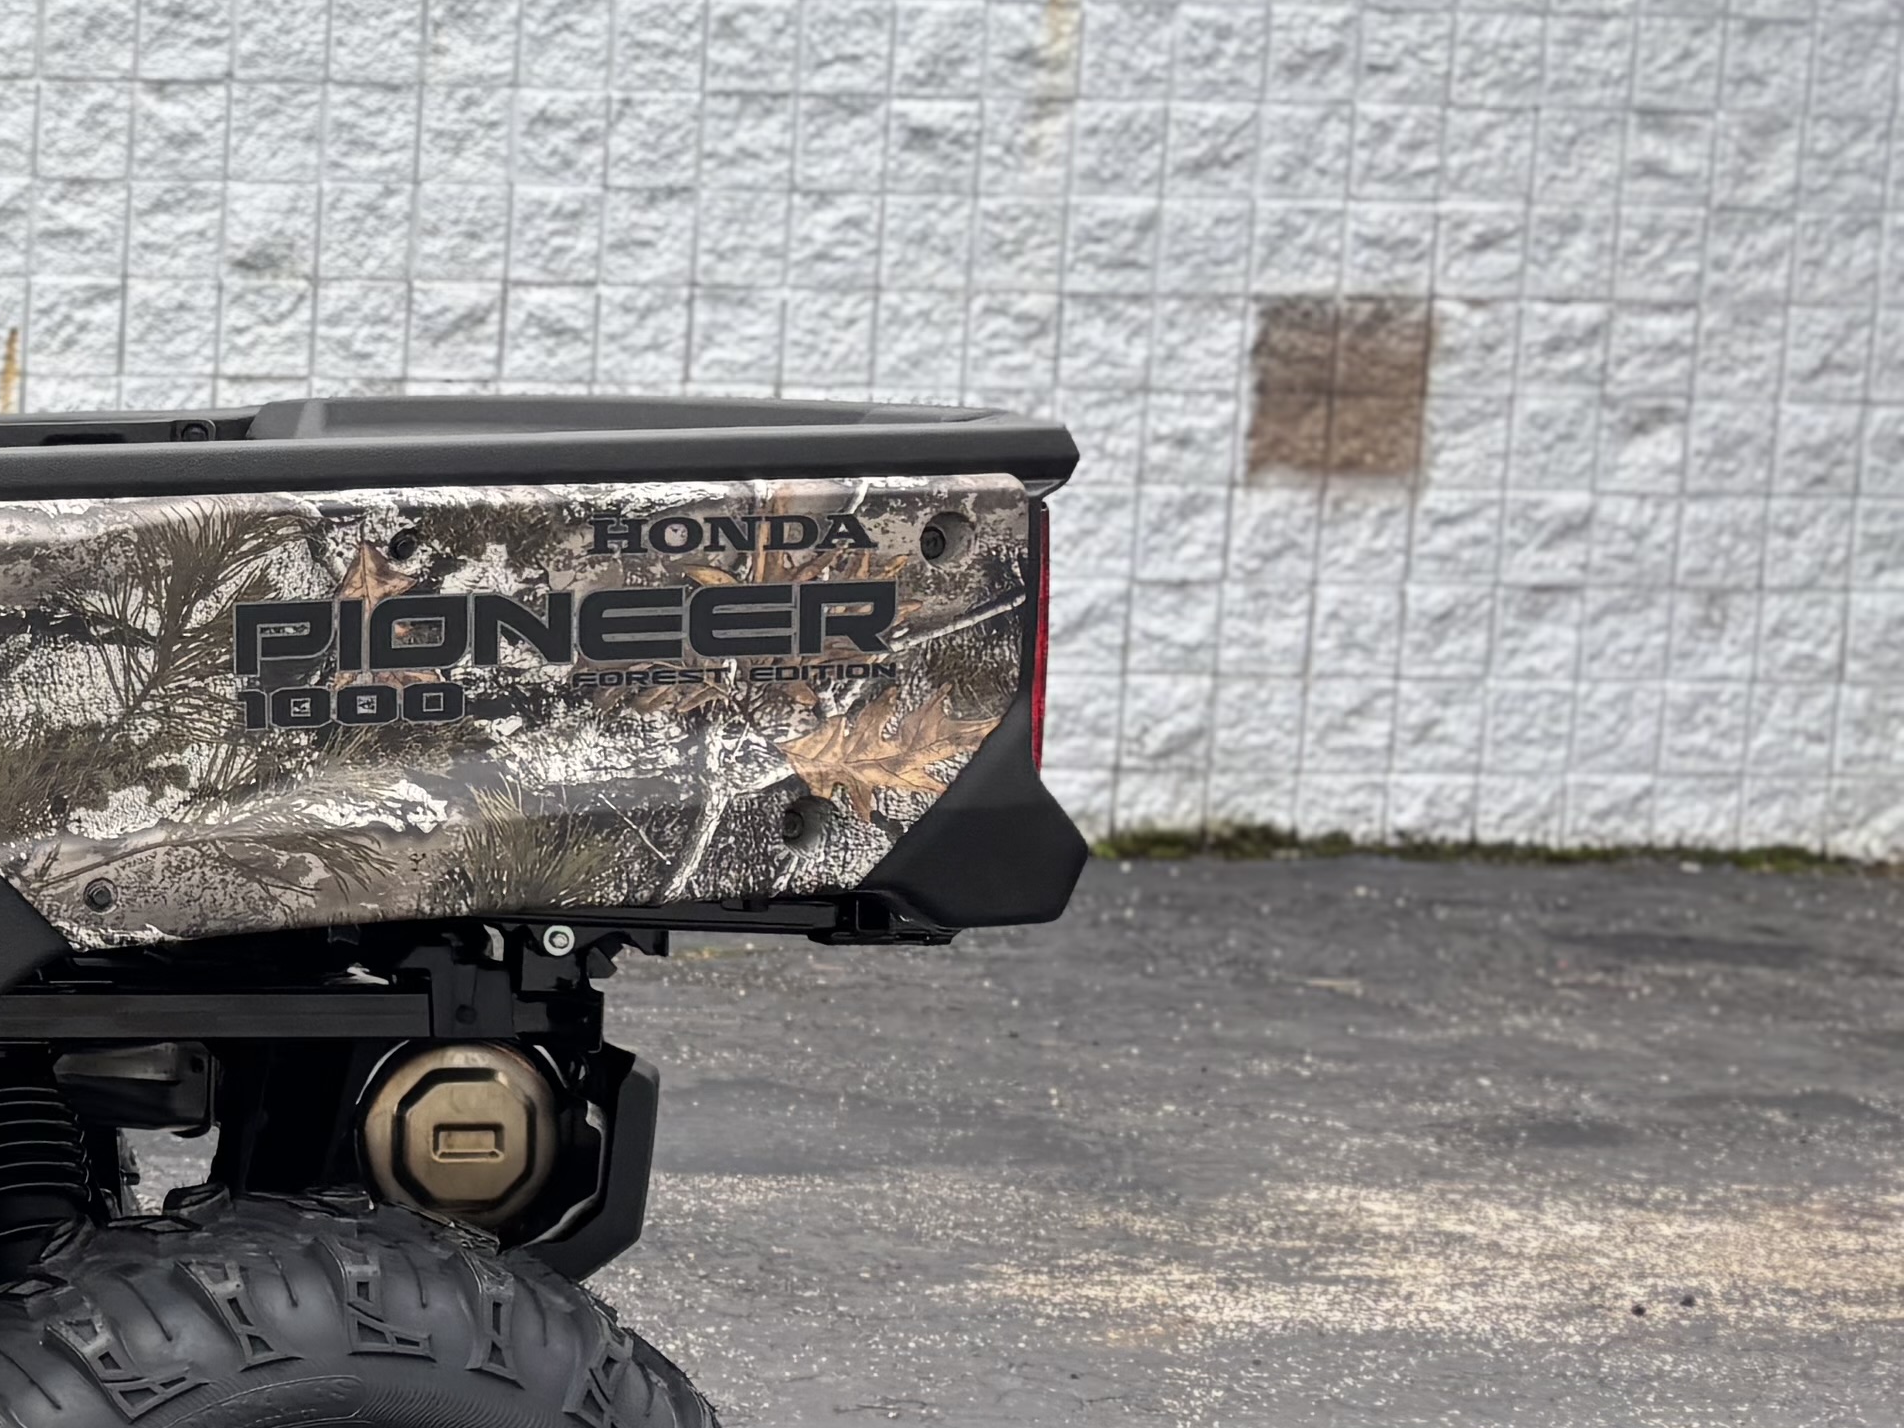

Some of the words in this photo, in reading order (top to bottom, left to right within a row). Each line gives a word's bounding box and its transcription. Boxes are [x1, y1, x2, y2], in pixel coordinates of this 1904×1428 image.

[592, 513, 879, 557] HONDA
[233, 580, 899, 675] PIONEER
[570, 668, 730, 689] FOREST
[748, 660, 898, 685] EDITION
[238, 682, 466, 732] 1000
